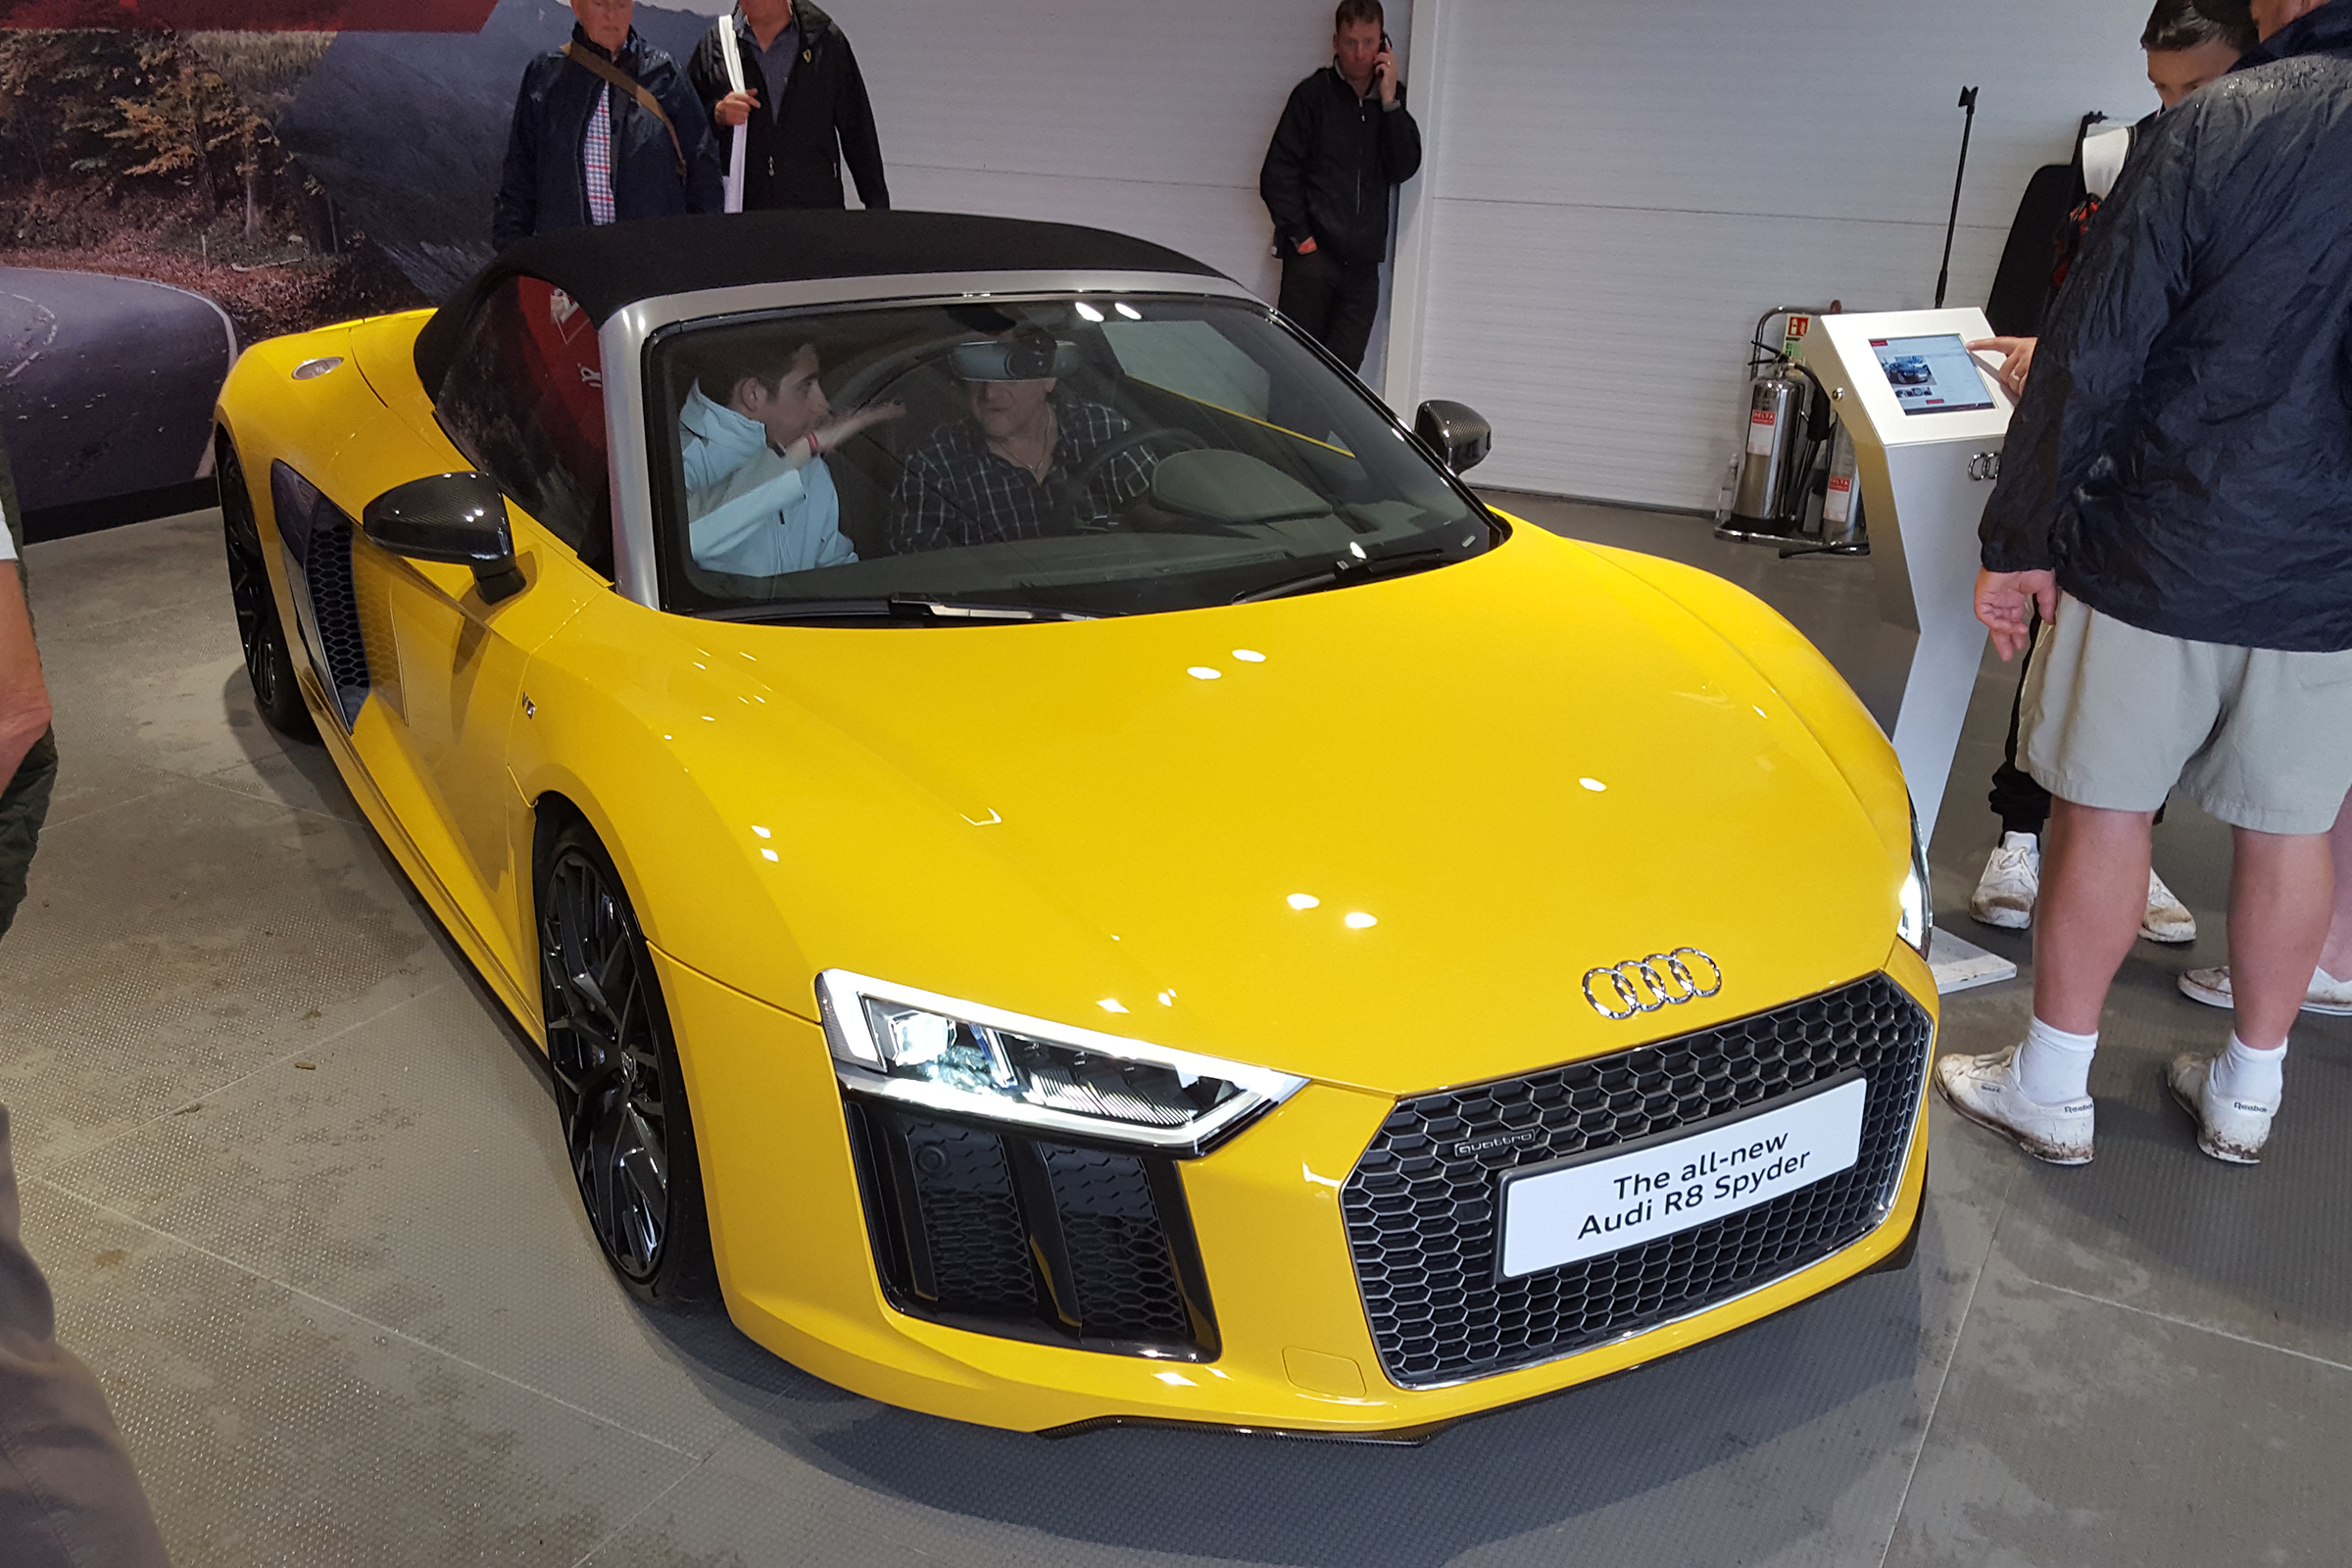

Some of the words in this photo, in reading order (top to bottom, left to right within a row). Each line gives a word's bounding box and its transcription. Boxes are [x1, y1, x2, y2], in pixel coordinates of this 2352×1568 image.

[1577, 1199, 1652, 1240] Audi
[1664, 1184, 1703, 1215] R8
[1714, 1152, 1811, 1199] Spyder
[1613, 1171, 1670, 1200] The
[1681, 1133, 1788, 1182] all-new
